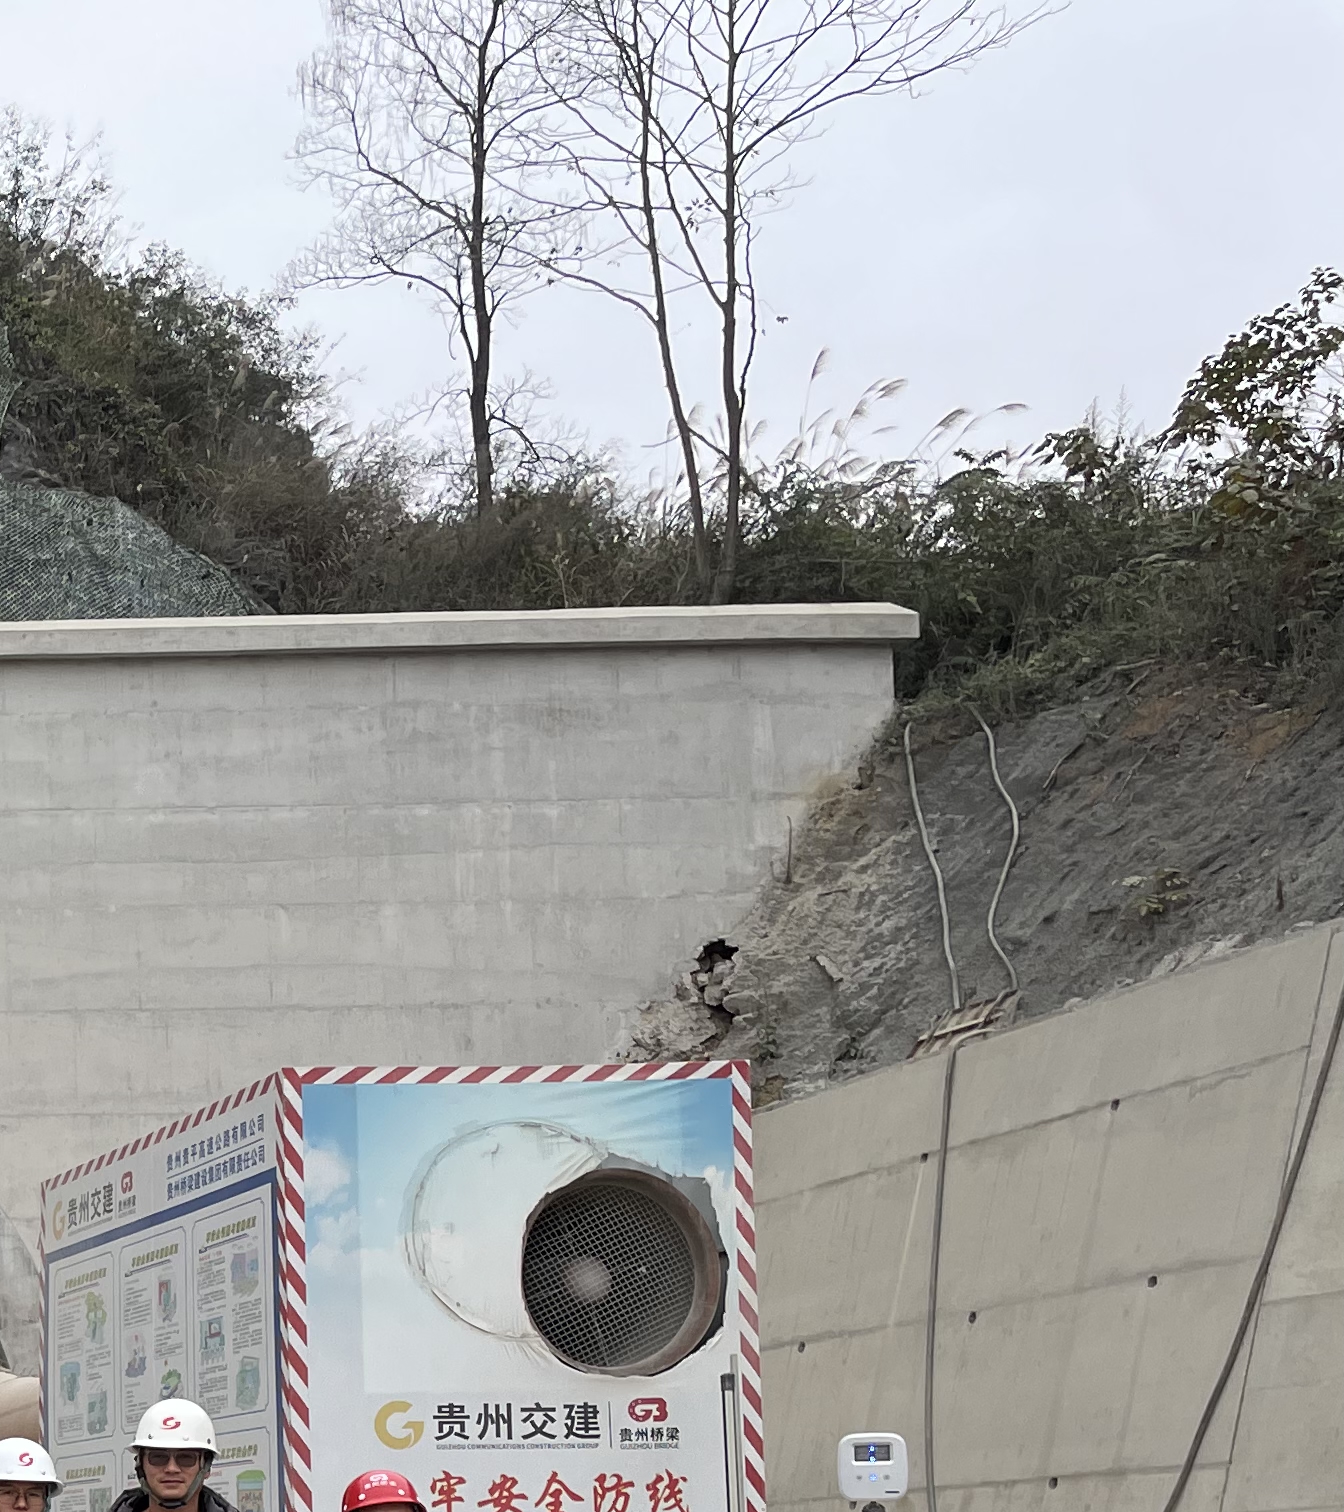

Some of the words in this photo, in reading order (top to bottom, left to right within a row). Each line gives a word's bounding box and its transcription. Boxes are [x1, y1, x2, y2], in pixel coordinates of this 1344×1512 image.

[167, 1114, 264, 1173] 贵州贵平高速公路有限公司
[68, 1182, 113, 1230] 贵州交建
[432, 1401, 601, 1441] 贵州交建
[619, 1427, 680, 1442] 贵州桥梁
